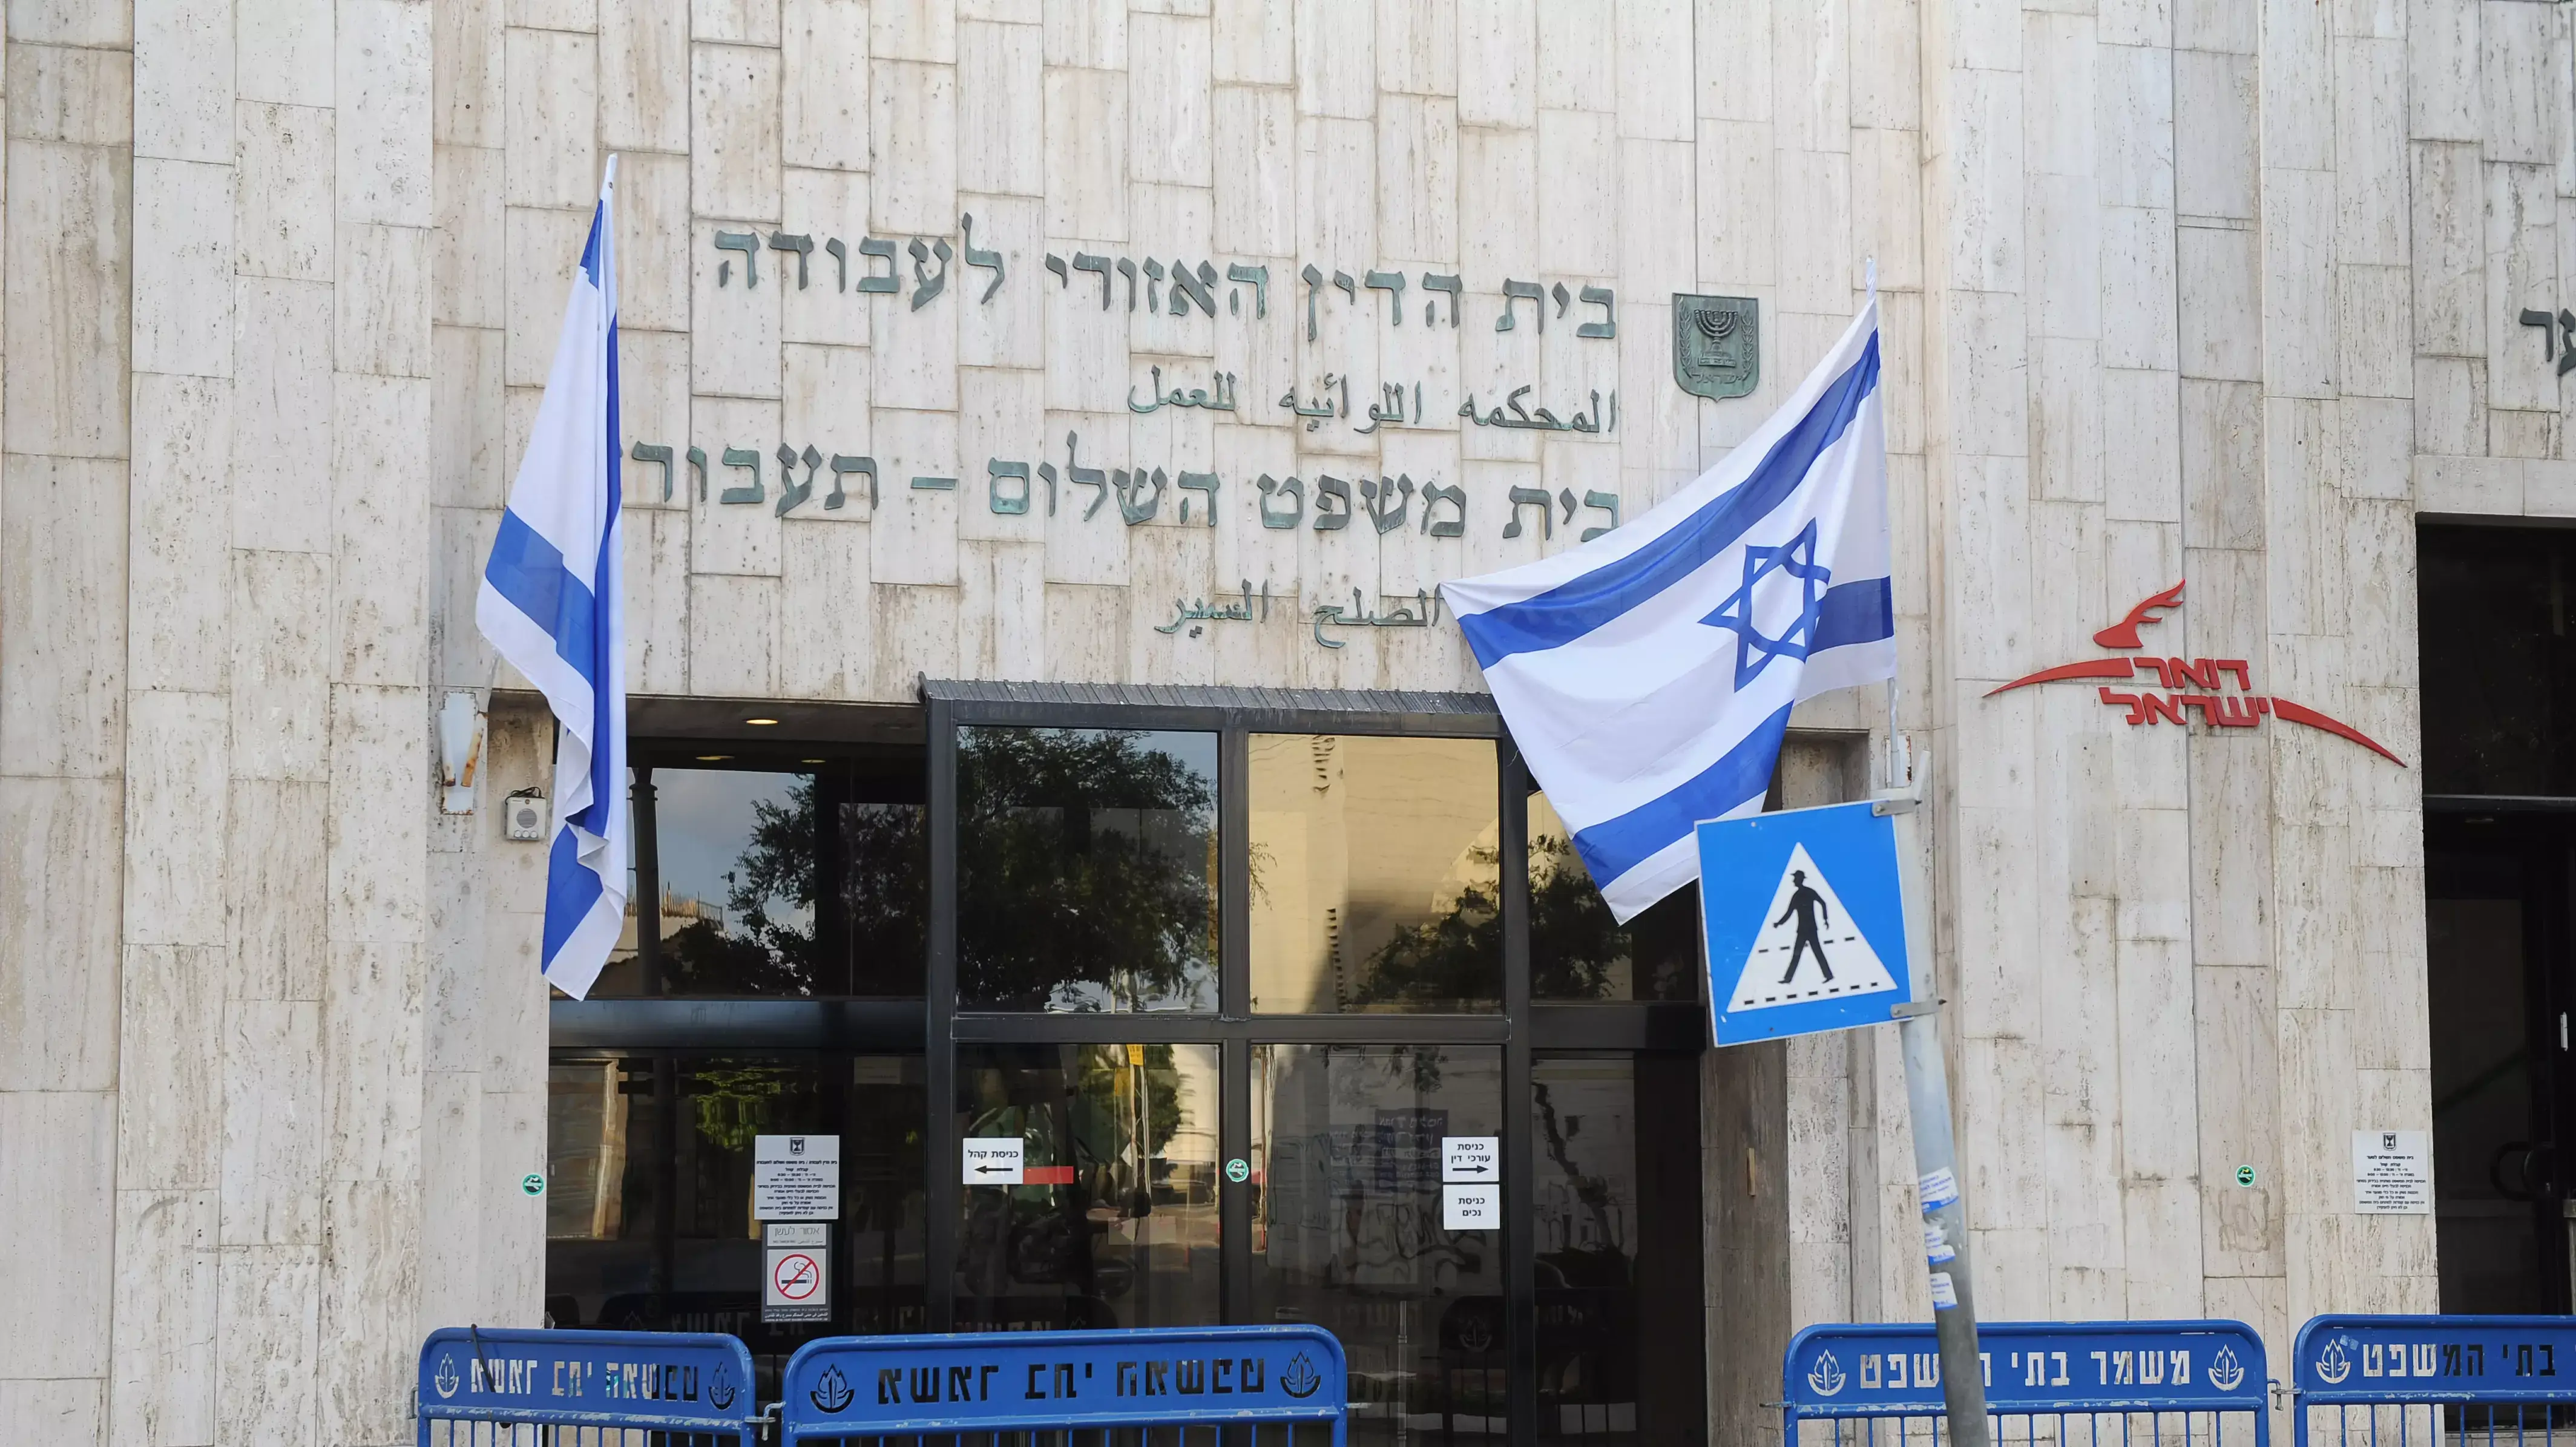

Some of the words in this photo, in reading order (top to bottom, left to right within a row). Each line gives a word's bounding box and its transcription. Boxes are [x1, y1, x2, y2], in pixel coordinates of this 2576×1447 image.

[714, 212, 1006, 312] לעבודה
[1045, 252, 1270, 320] האזורי
[1301, 263, 1463, 343] הדין
[1495, 277, 1617, 340] בית
[1127, 364, 1236, 414] للعمل
[619, 441, 879, 518] תעבור
[988, 430, 1221, 527] השלום
[1257, 473, 1467, 537] משפט
[1503, 485, 1620, 542] בית
[1154, 578, 1269, 639] السير
[1313, 581, 1441, 649] الصلح
[2134, 657, 2251, 691] דואר
[2098, 686, 2270, 727] ישראל
[967, 1149, 987, 1160] קהל
[1451, 1155, 1462, 1164] דין
[775, 1226, 795, 1237] לעשן
[1860, 1353, 1991, 1389] השפט
[2011, 1351, 2070, 1387] בתי
[2090, 1350, 2191, 1386] משמר
[2363, 1344, 2483, 1377] המשפט
[2502, 1344, 2557, 1377] בתי
